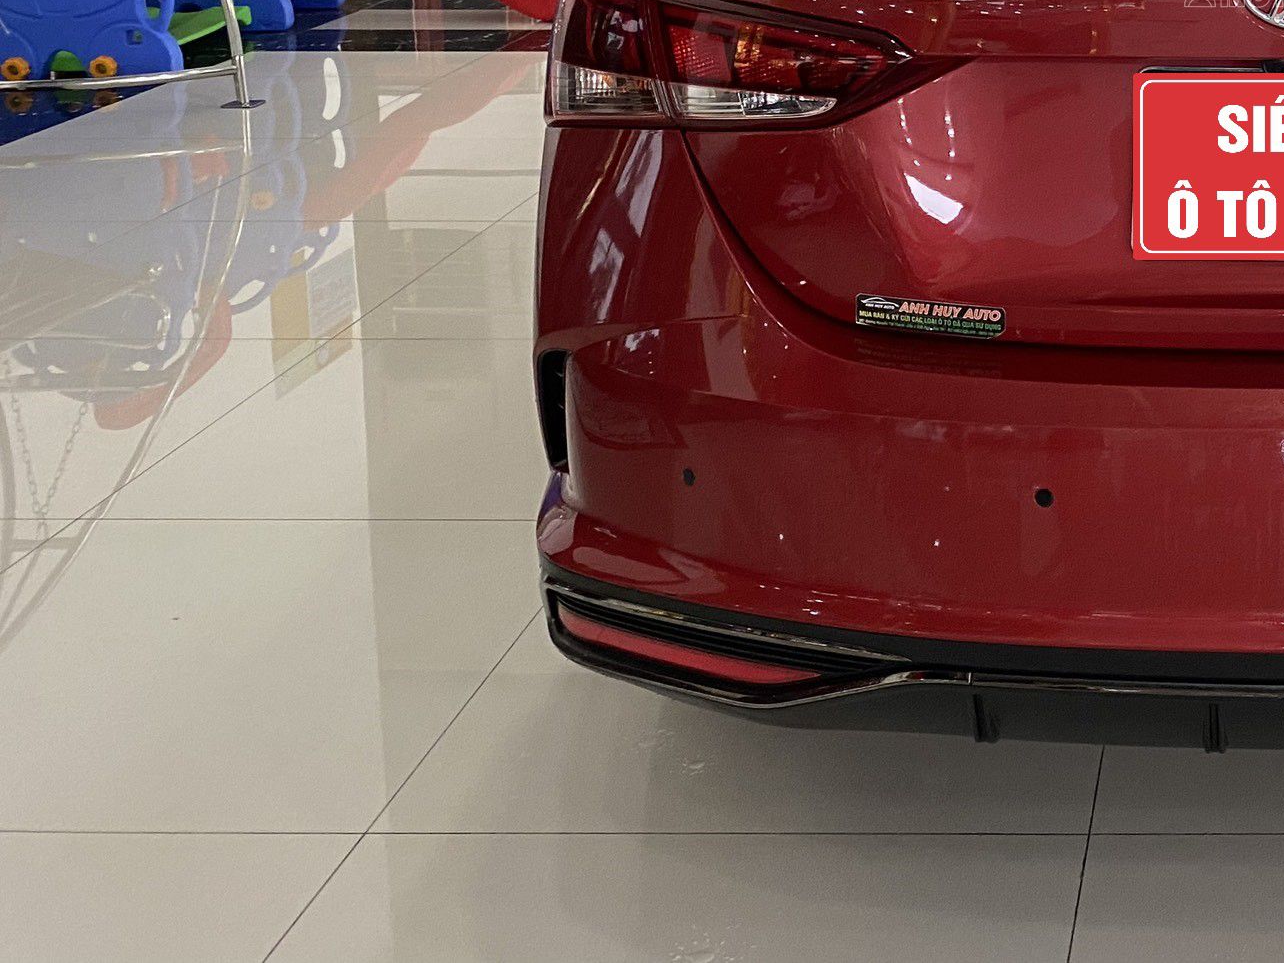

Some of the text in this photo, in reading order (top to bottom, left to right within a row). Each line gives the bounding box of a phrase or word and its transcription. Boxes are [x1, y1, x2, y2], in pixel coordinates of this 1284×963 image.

[899, 301, 1001, 322] ANH HUY AUTO
